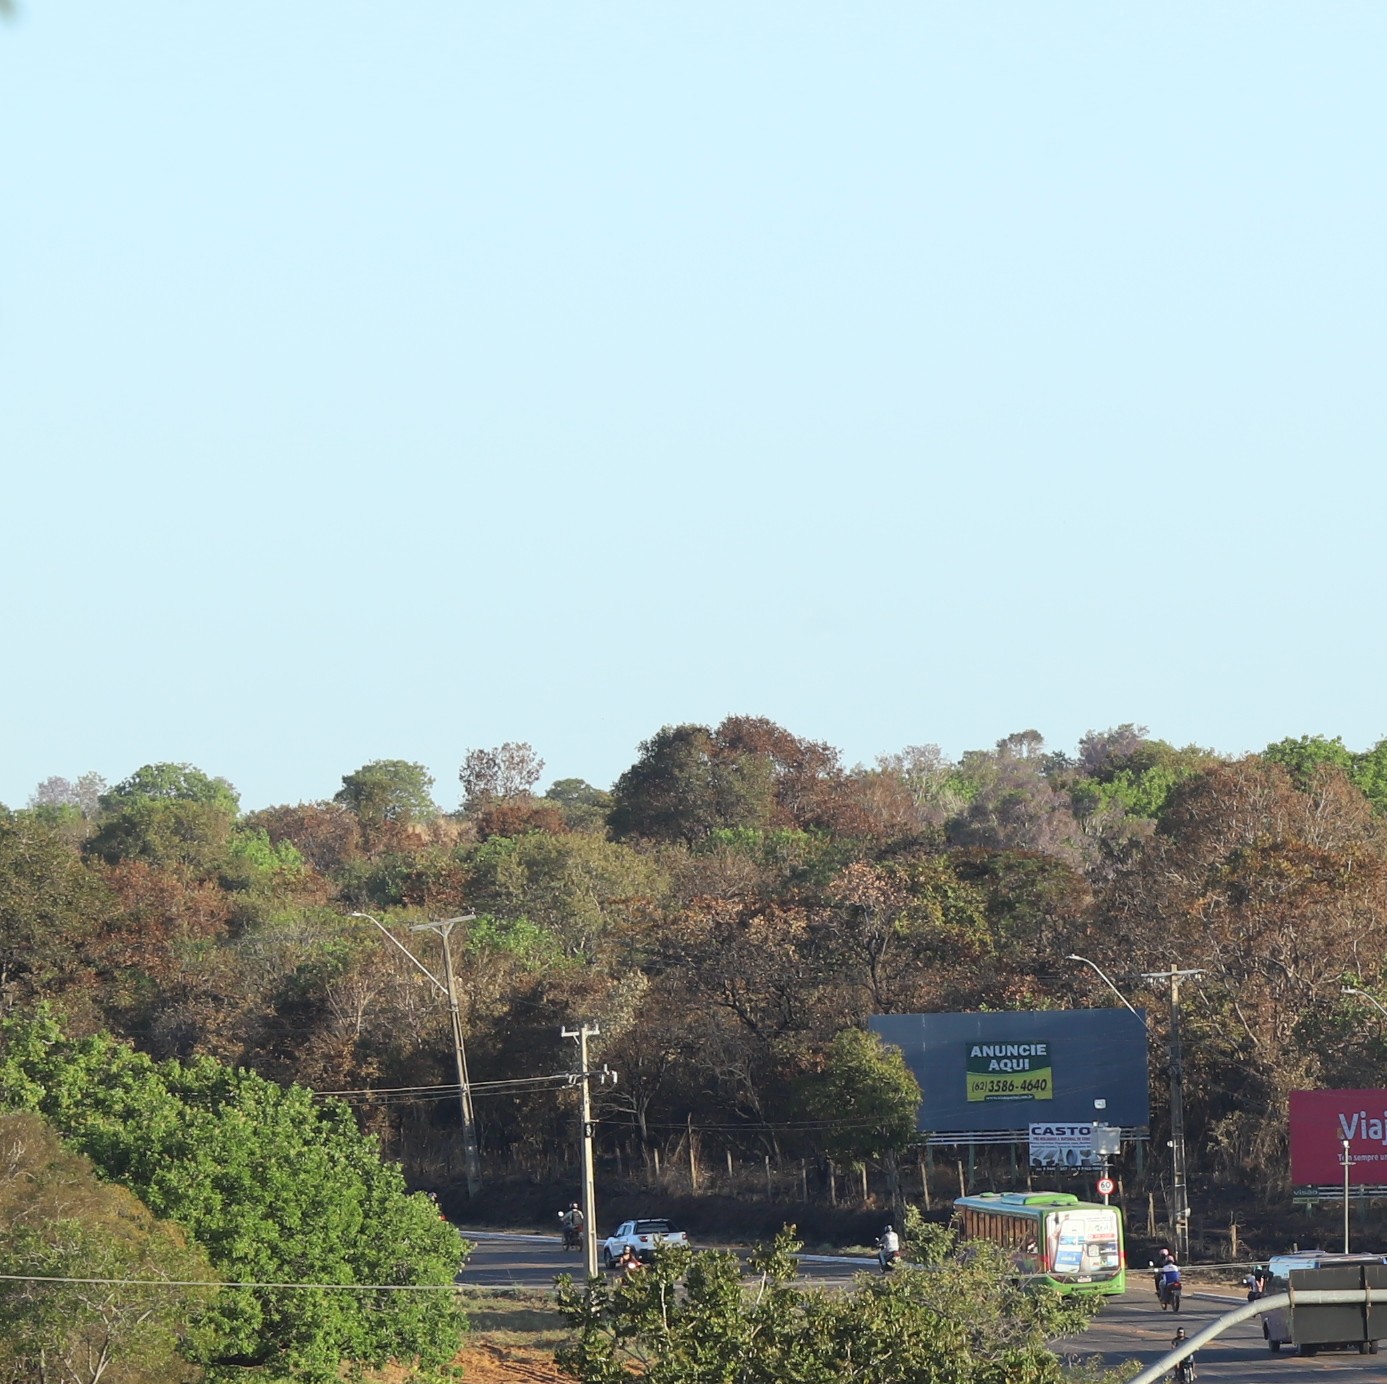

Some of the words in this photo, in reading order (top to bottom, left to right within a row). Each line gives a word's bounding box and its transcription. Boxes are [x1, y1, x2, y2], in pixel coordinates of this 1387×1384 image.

[970, 1044, 1047, 1057] ANUNCIE
[988, 1058, 1030, 1072] AQUI
[1354, 1154, 1379, 1163] sempre
